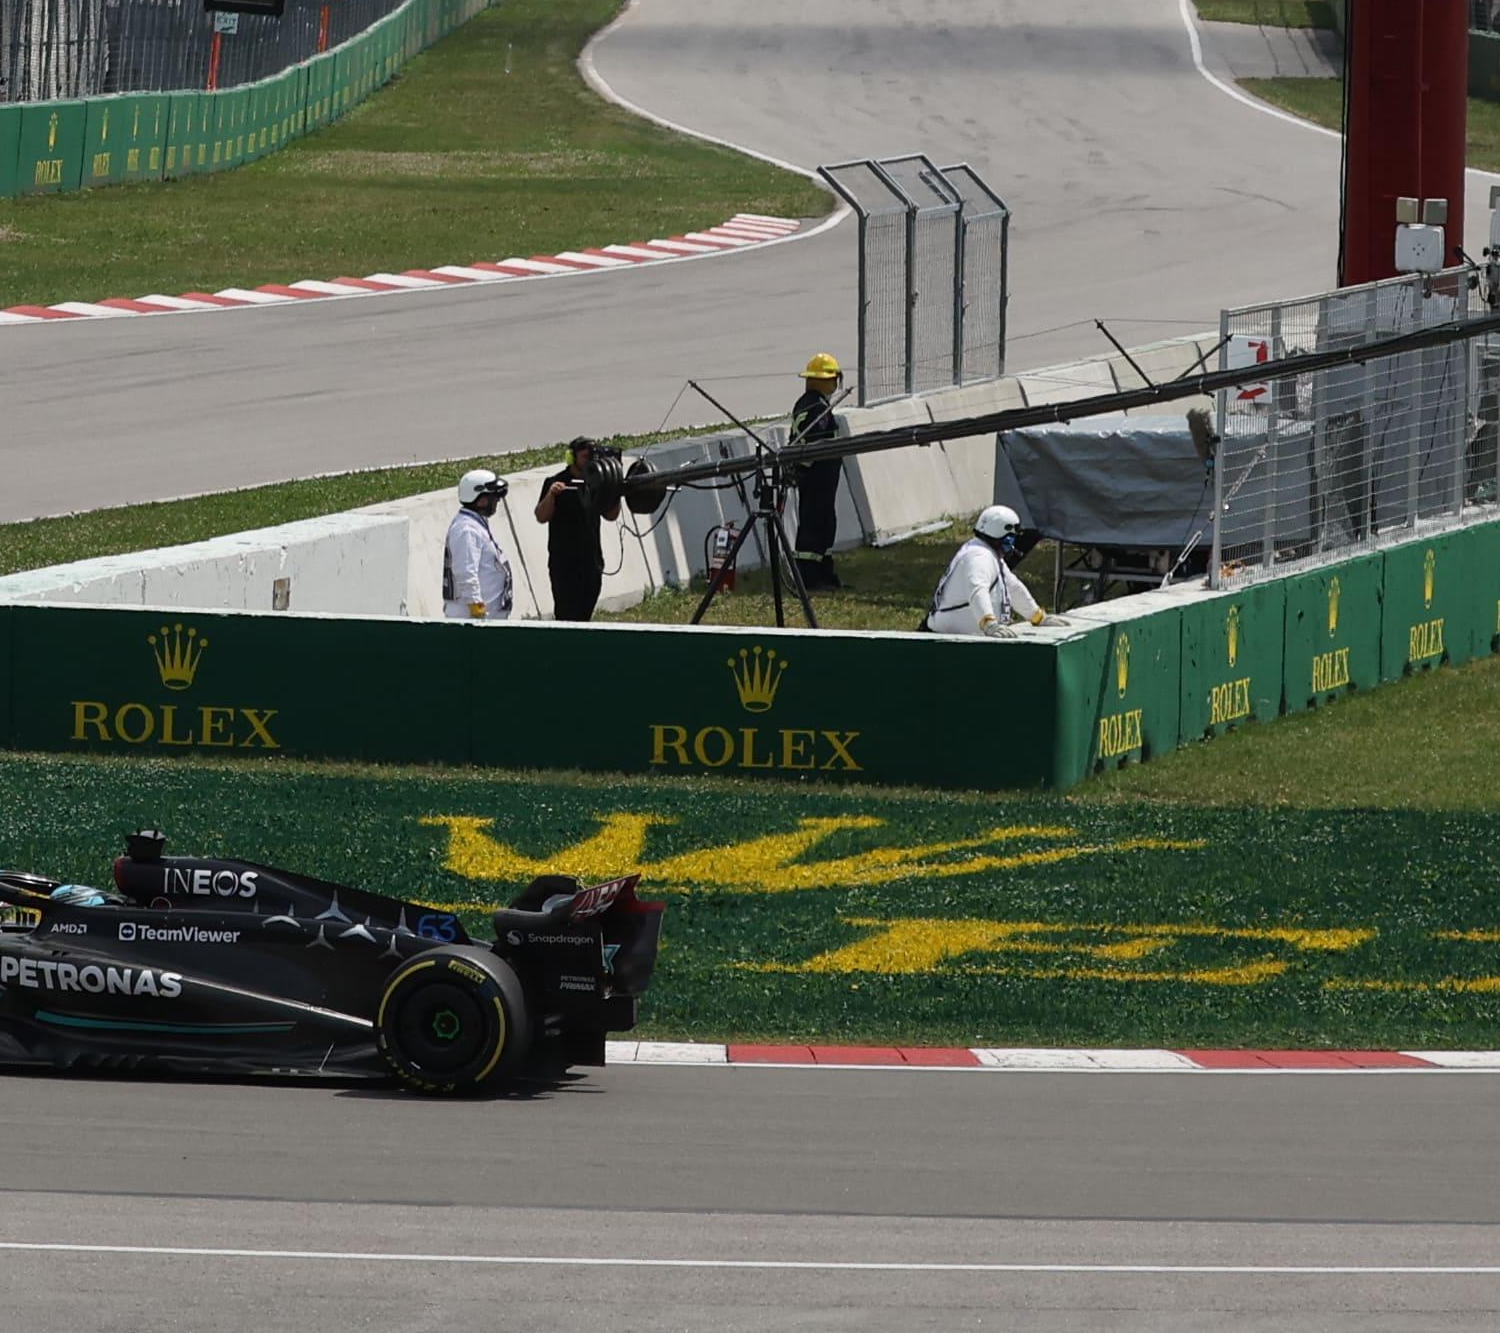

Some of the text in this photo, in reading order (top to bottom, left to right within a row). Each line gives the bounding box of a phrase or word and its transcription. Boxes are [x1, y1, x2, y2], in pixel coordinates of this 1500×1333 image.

[1410, 619, 1445, 661] ROLEX
[1312, 648, 1351, 693] ROLEX
[1210, 677, 1251, 725] ROLEX
[74, 701, 277, 749] ROLEX
[1099, 709, 1143, 757] ROLEX
[652, 725, 861, 770] ROLEX
[163, 868, 259, 898] INEOS
[50, 923, 77, 934] AMD
[137, 925, 241, 944] TeamViewer
[417, 914, 458, 943] 63
[528, 933, 594, 945] Snapdragon
[0, 956, 183, 998] PETRONAS
